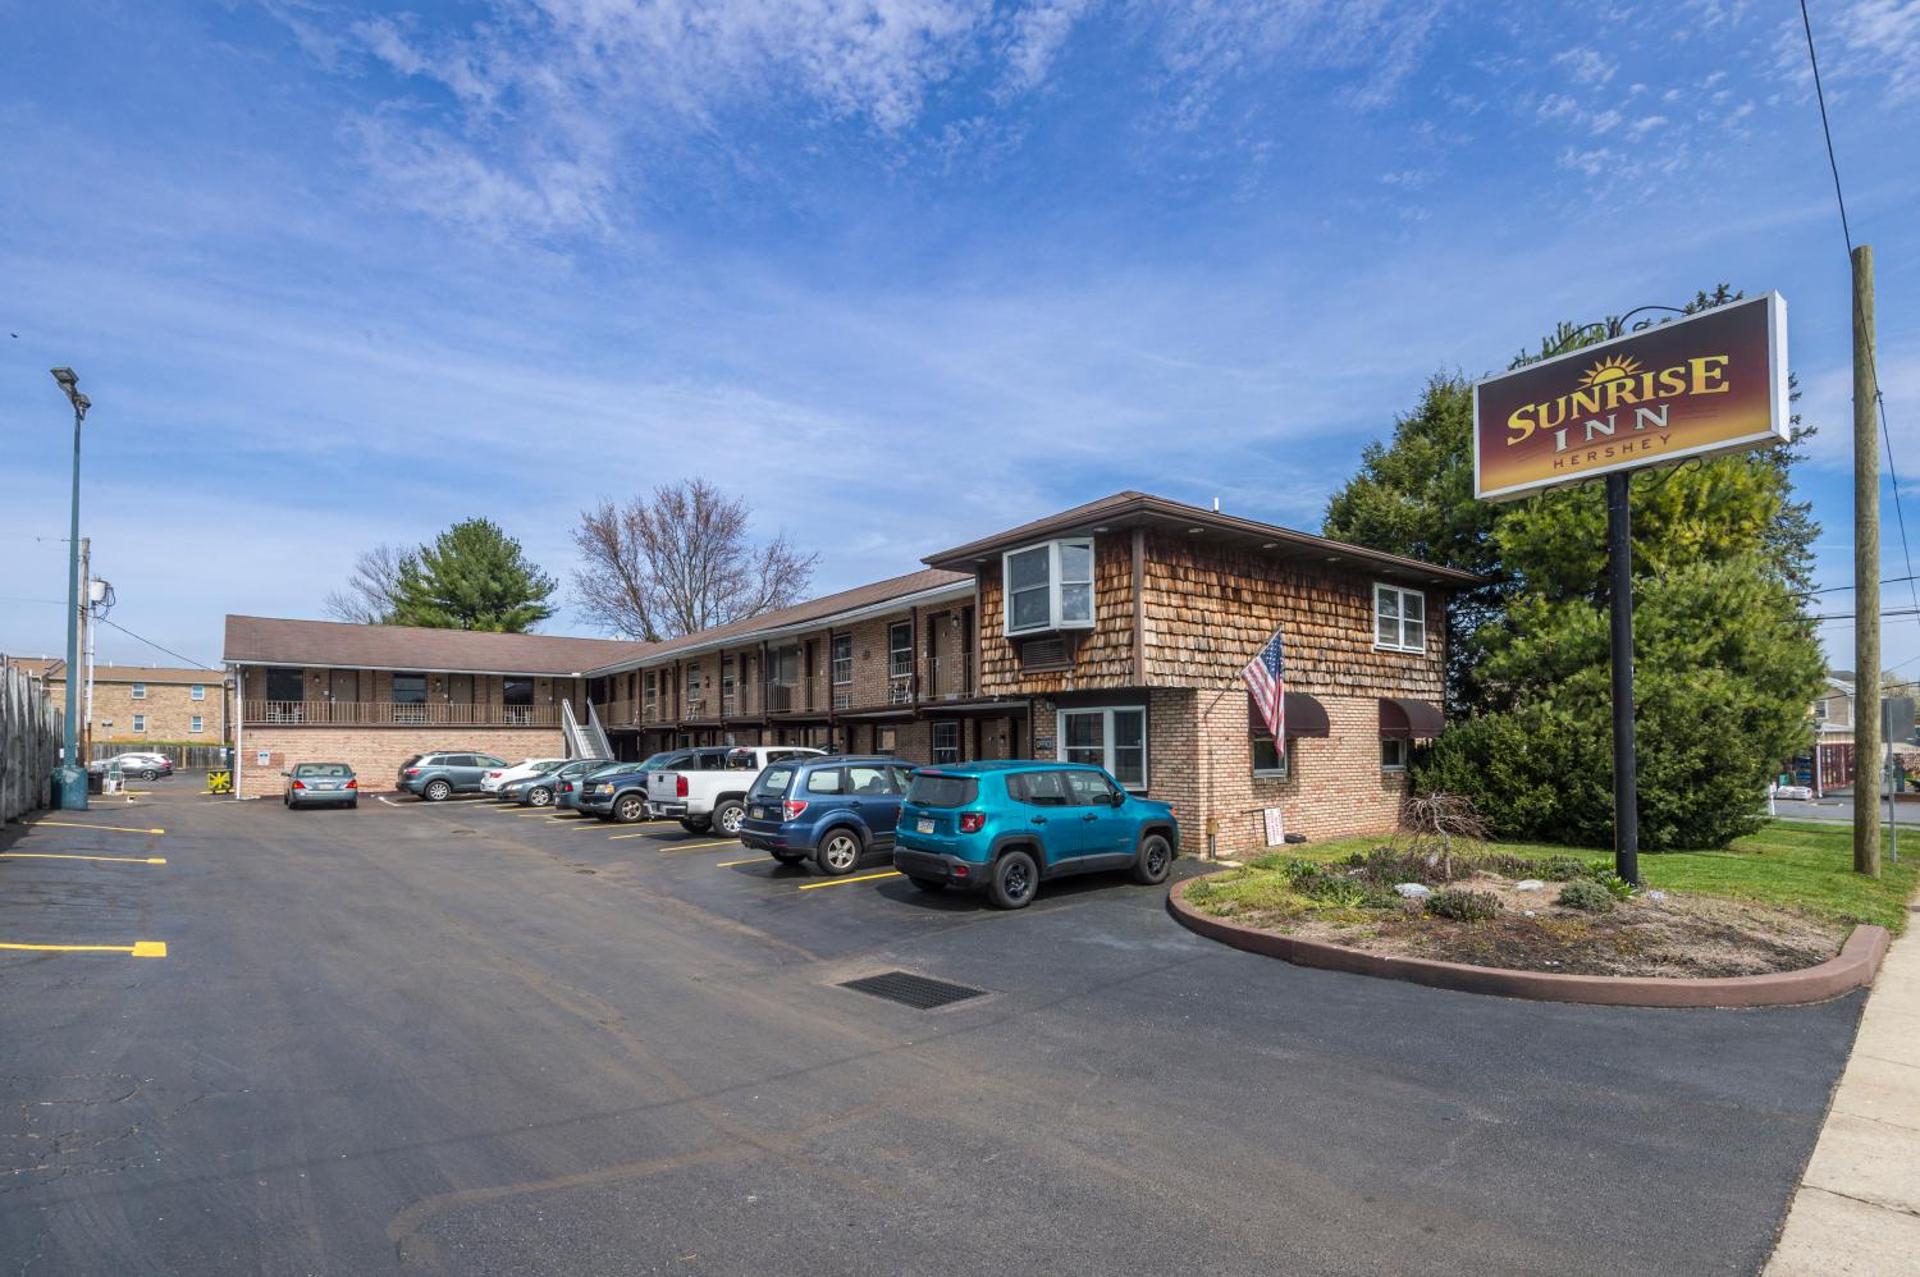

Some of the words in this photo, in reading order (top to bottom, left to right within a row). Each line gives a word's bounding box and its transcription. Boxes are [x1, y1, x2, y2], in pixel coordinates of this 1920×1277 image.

[1507, 355, 1730, 446] SUNRISE
[1554, 404, 1669, 451] INN
[1553, 434, 1672, 469] HERSHEY
